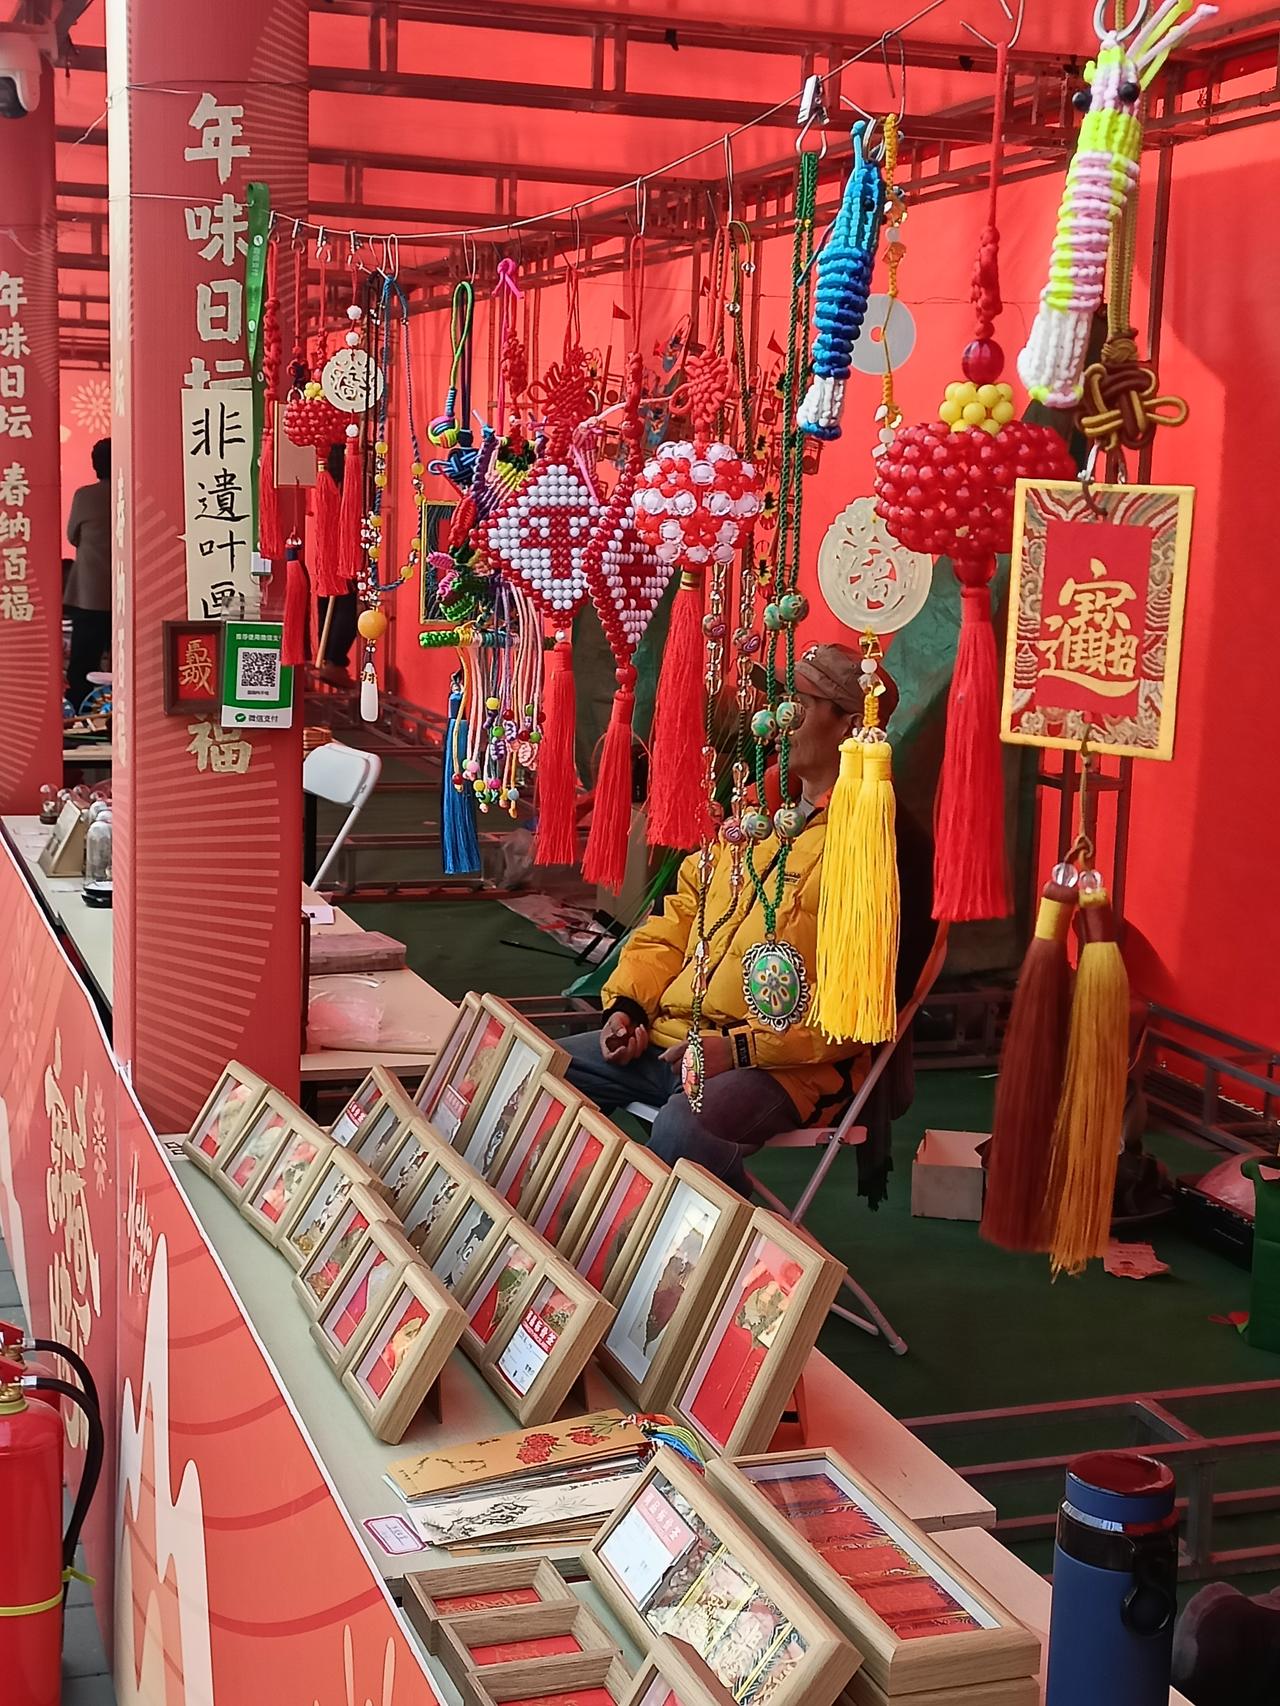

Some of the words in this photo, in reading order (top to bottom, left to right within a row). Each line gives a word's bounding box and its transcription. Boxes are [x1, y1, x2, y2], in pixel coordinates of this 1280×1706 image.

[0, 462, 34, 621] 春纳百福
[248, 714, 279, 724] 微信支付
